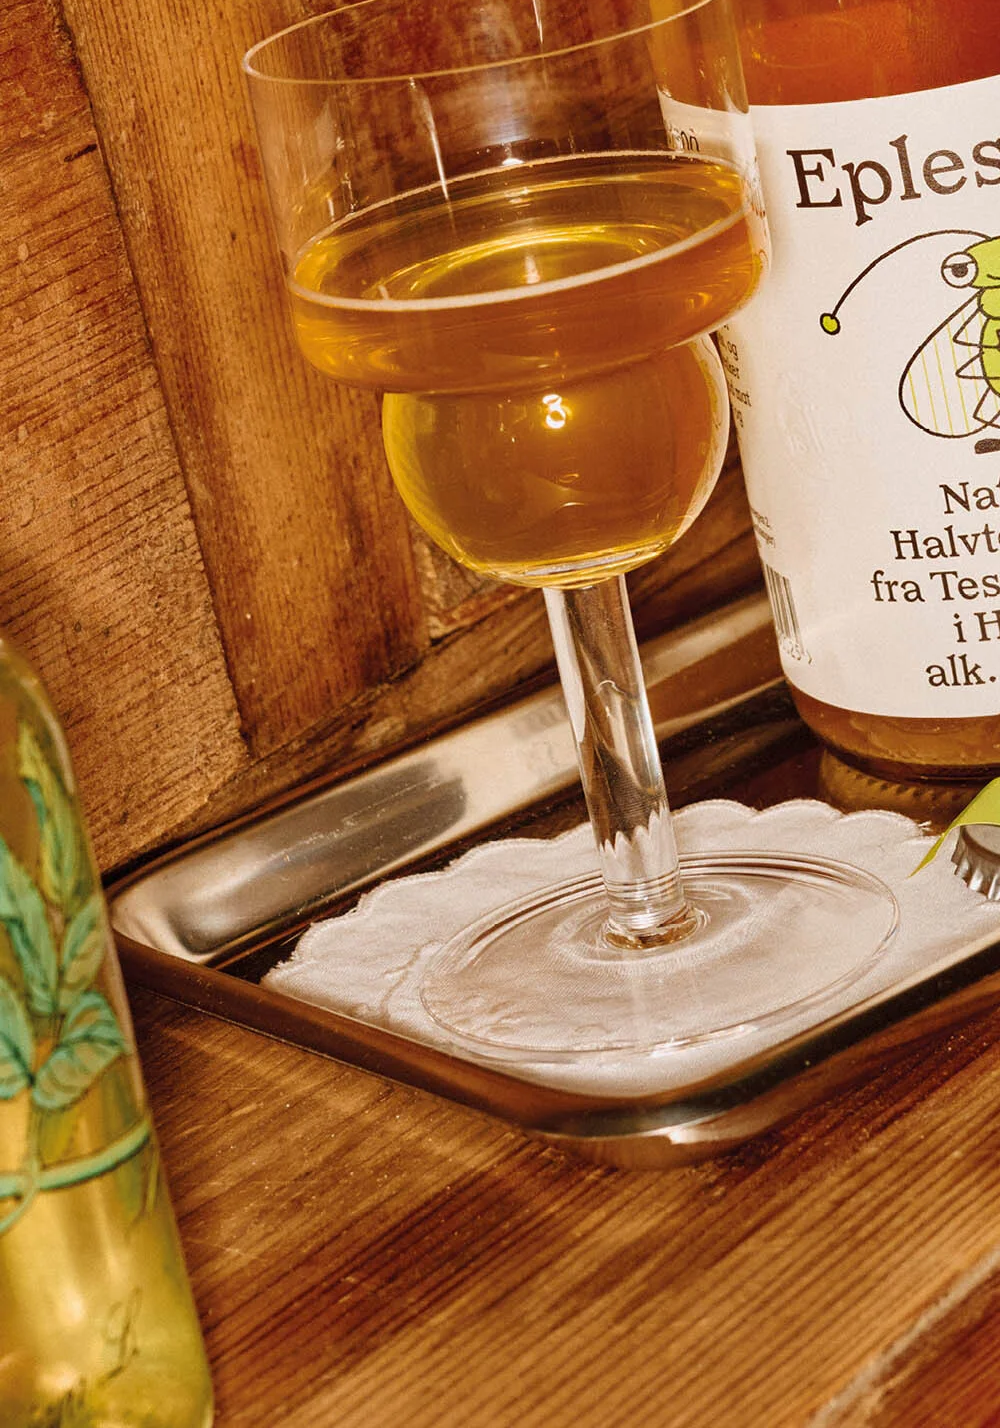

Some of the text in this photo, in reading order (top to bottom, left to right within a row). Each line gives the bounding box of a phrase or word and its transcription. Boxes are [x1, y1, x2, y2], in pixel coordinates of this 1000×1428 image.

[870, 569, 925, 603] fra
[953, 613, 967, 643] i
[925, 654, 998, 687] alk.
